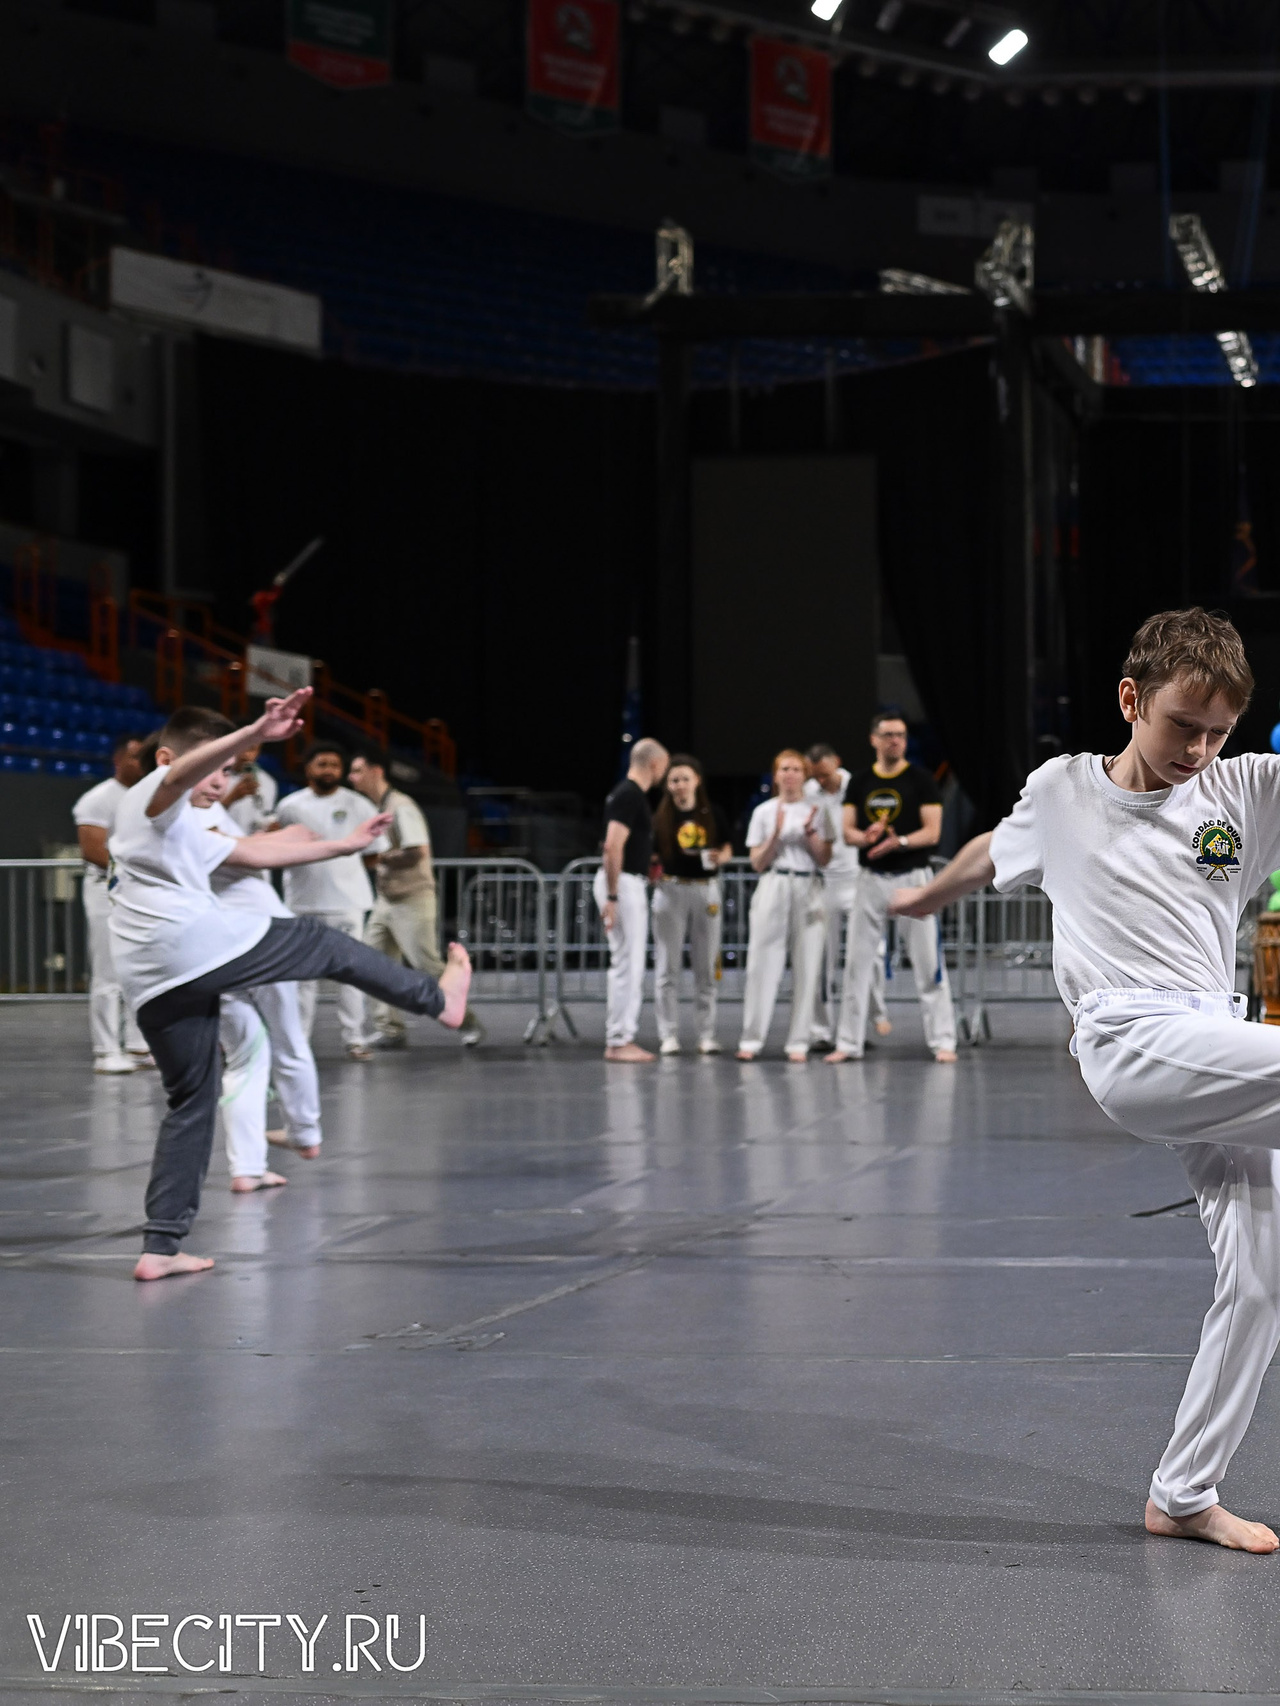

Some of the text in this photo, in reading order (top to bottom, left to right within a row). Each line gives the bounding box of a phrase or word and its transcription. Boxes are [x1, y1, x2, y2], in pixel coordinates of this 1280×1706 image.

[1192, 819, 1243, 850] CORDÃO DE OURO
